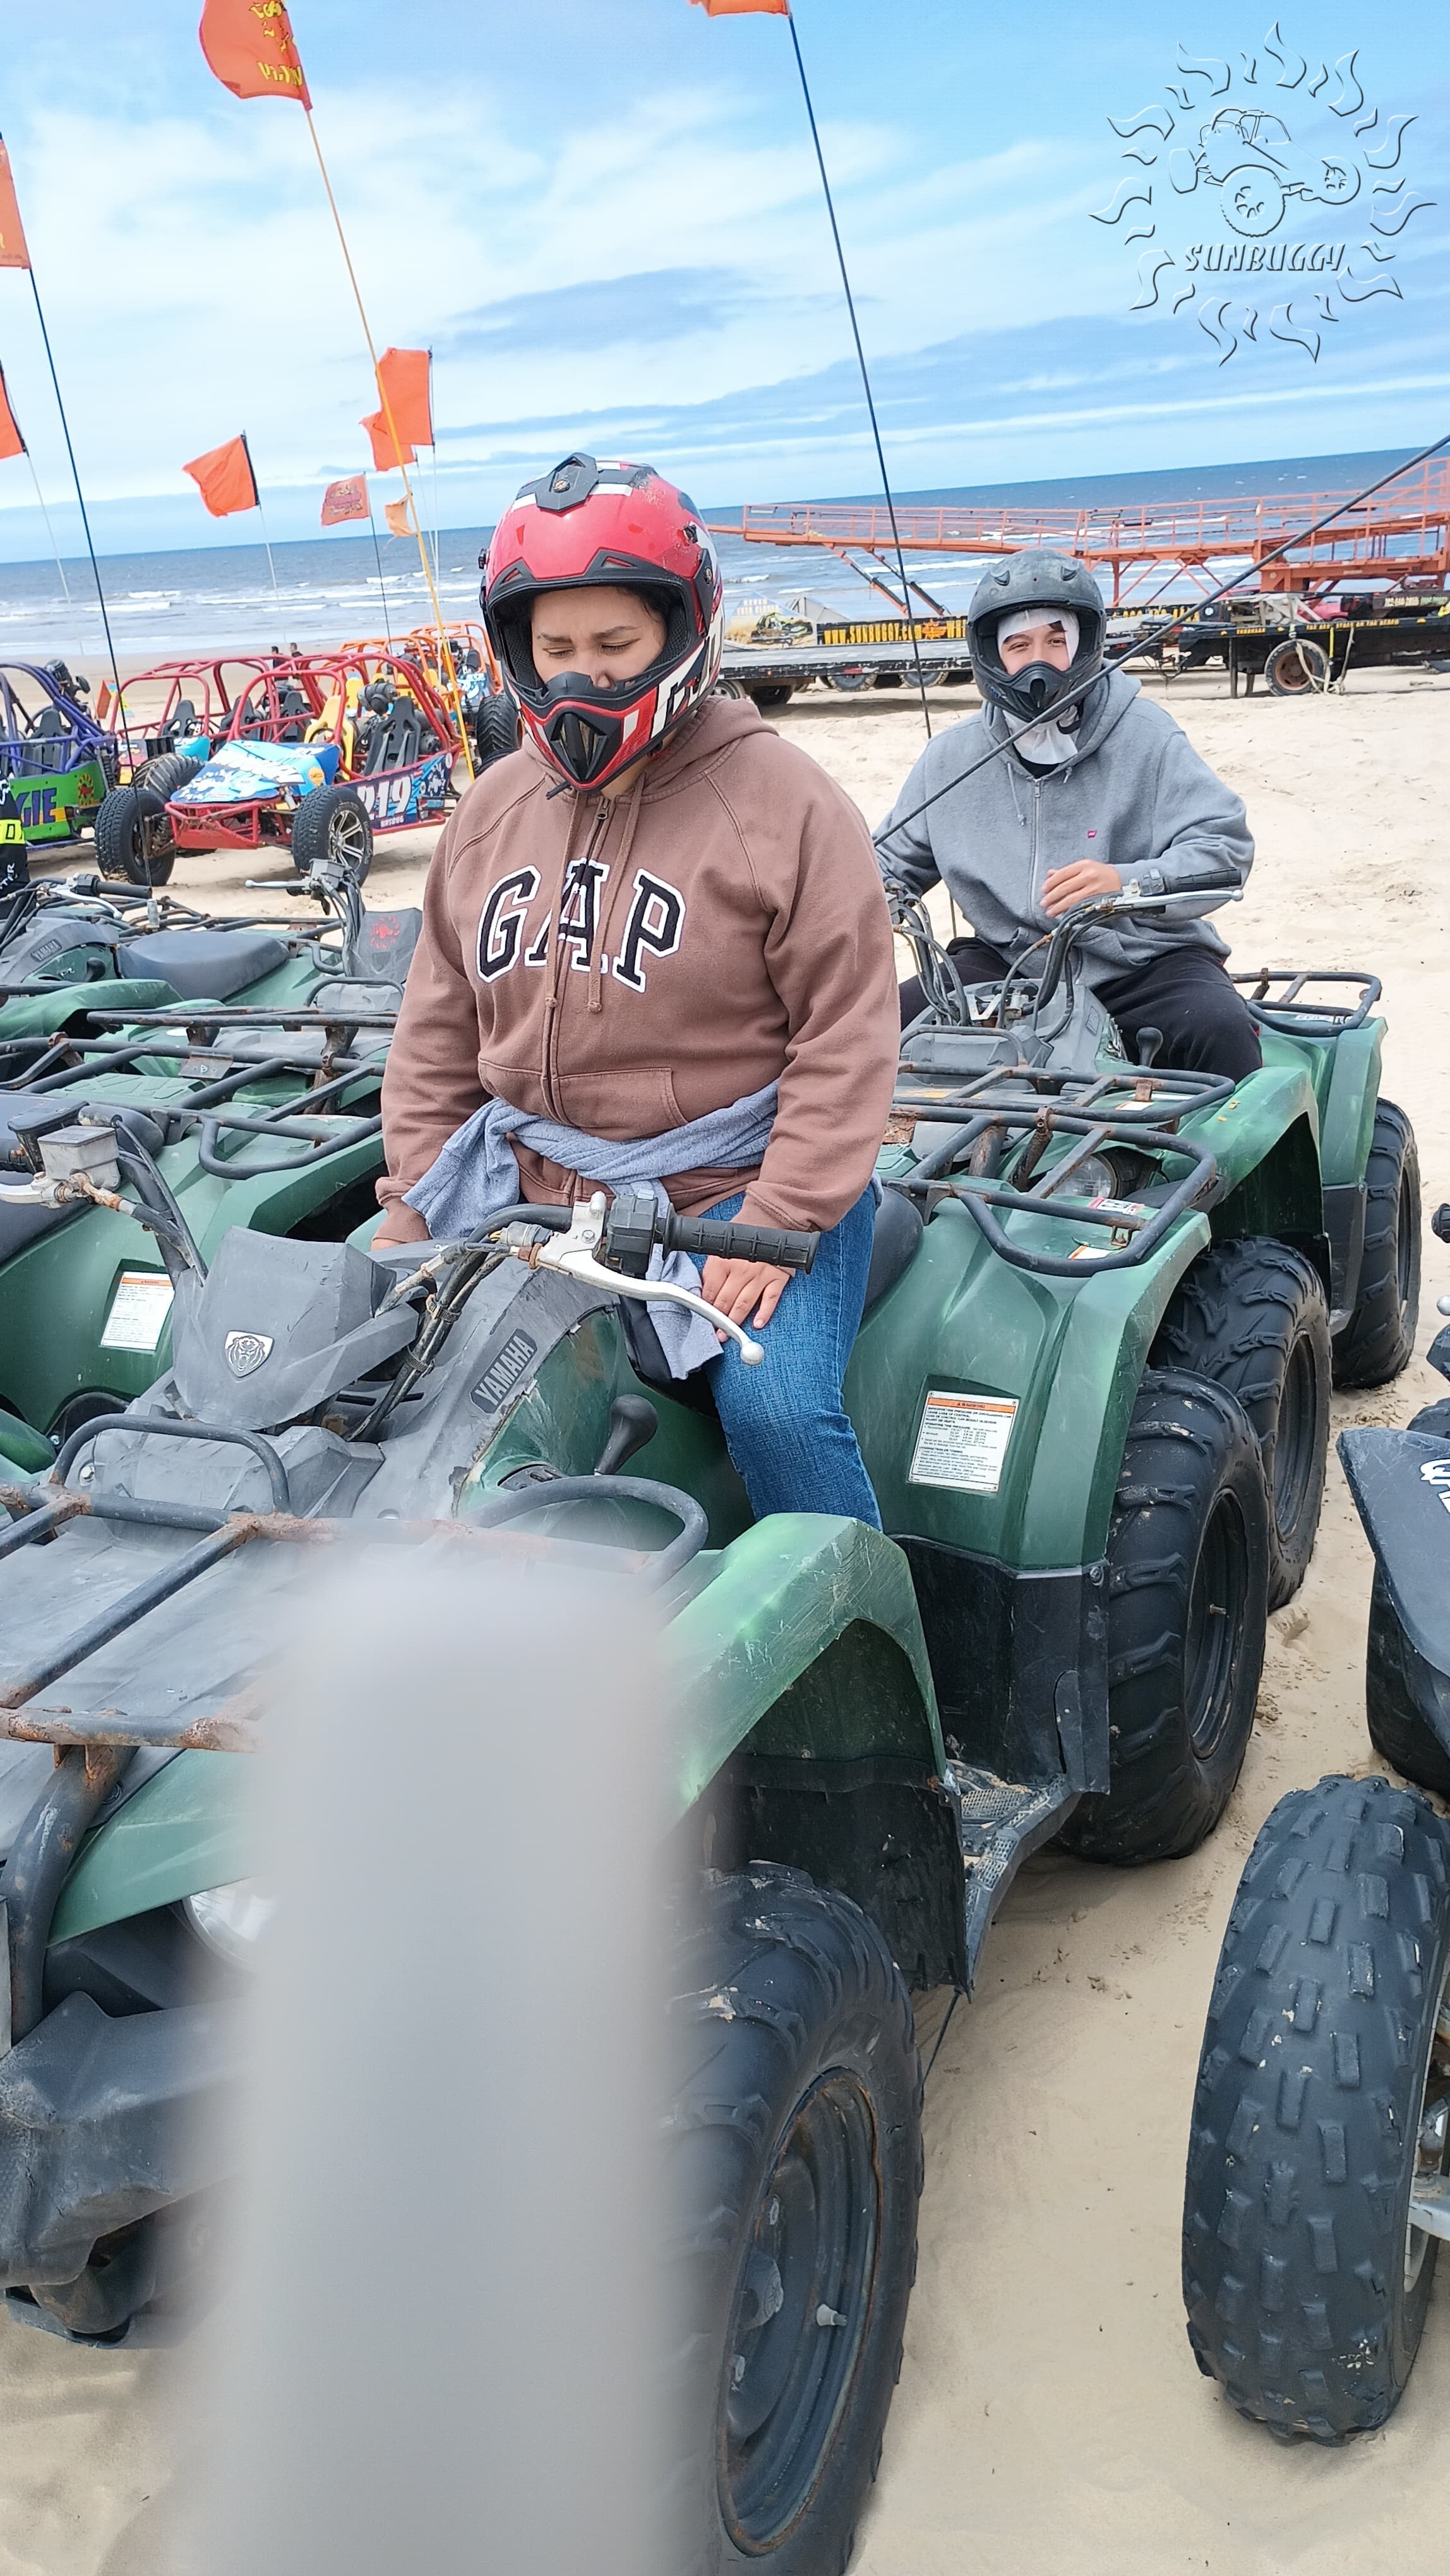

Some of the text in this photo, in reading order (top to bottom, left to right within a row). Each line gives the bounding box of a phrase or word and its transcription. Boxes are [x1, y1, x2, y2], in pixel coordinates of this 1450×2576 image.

[357, 775, 411, 818] 219
[32, 939, 61, 960] YAMAHA
[476, 857, 687, 993] GAP
[474, 1335, 535, 1406] YAMAHA
